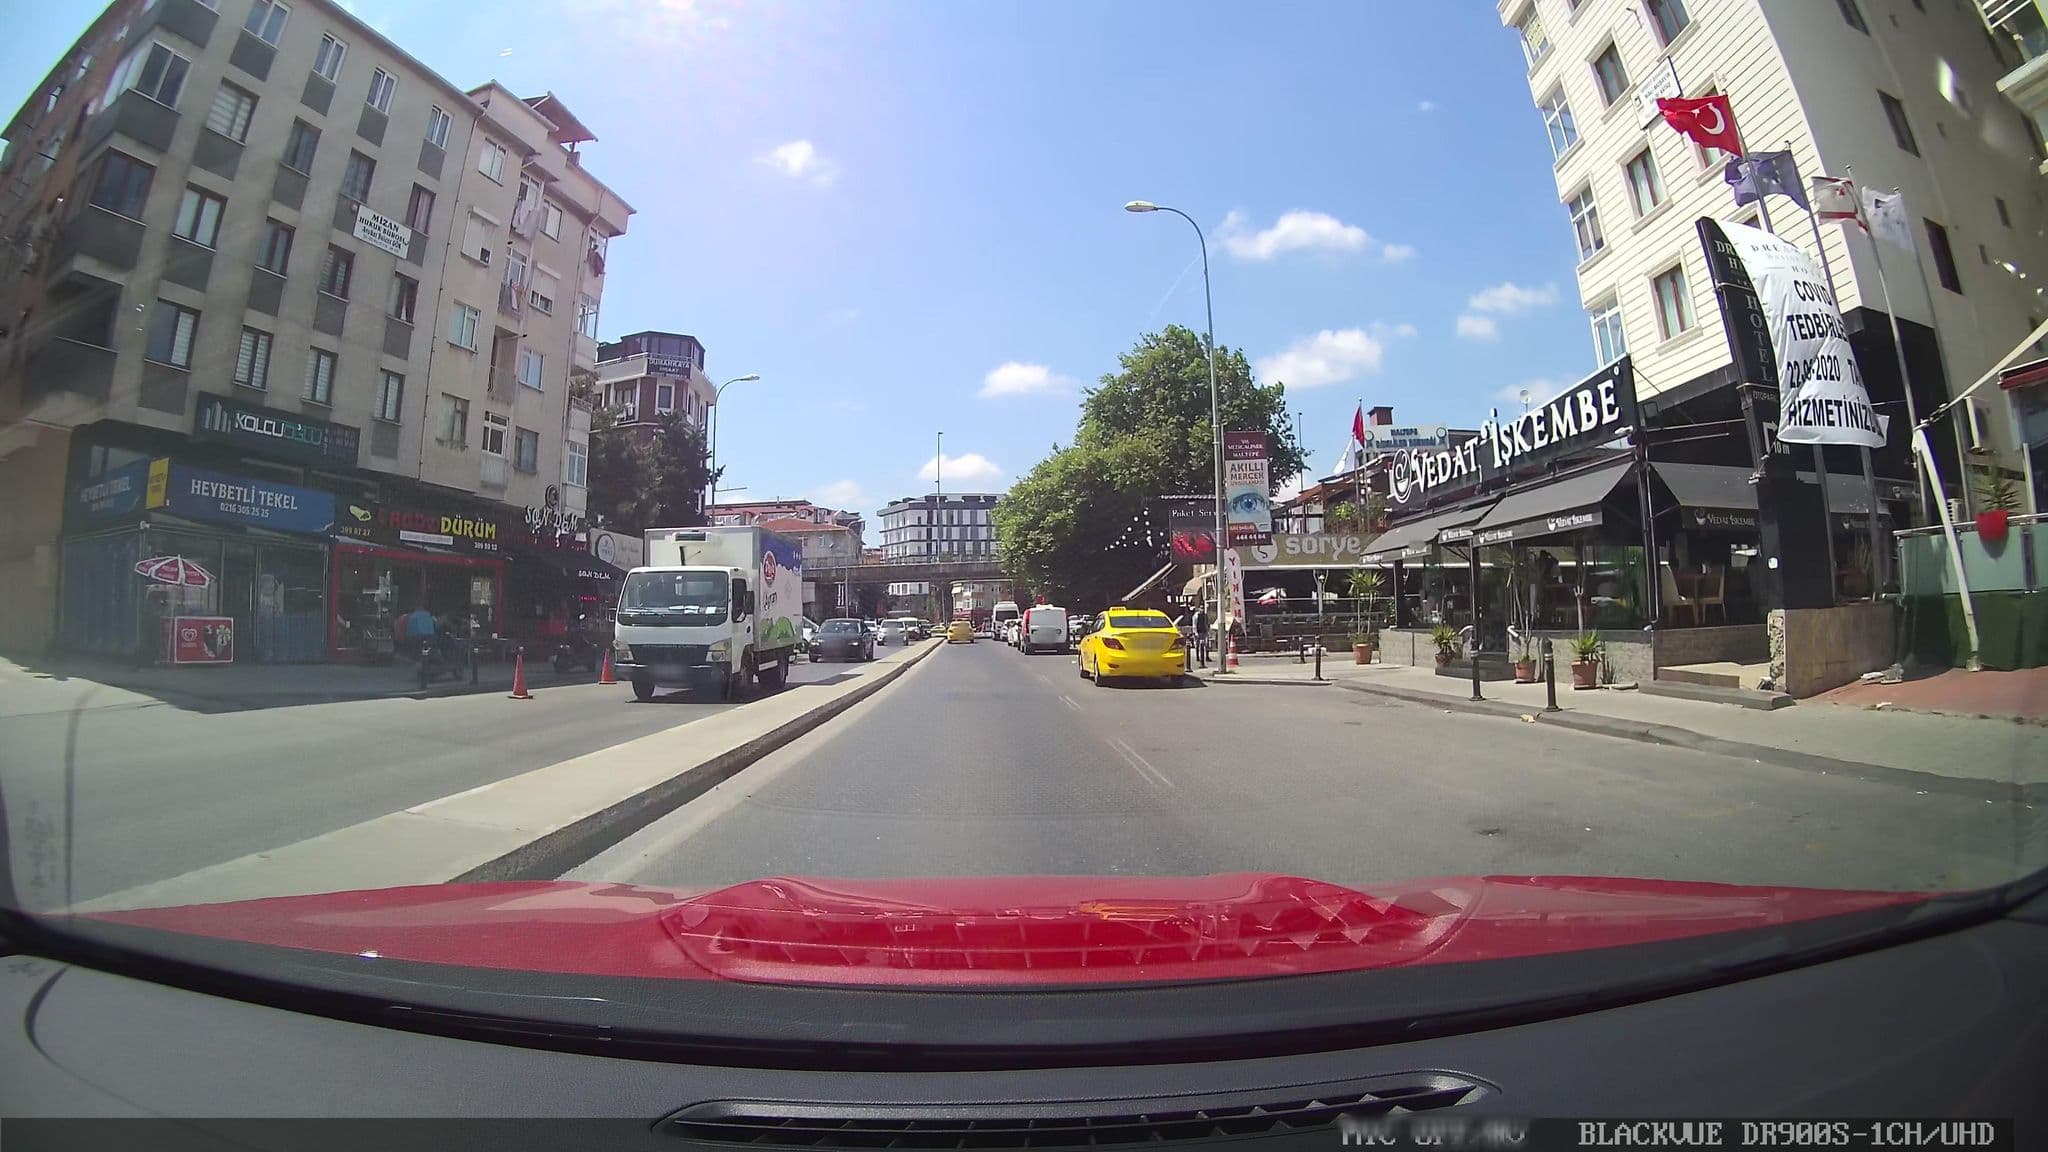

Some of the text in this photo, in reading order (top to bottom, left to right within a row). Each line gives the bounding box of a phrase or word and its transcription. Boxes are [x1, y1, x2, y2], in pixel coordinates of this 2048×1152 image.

[1794, 279, 1832, 306] COVID
[1746, 295, 1773, 381] HOTEL
[1481, 378, 1620, 470] İŞKEMBE
[190, 478, 256, 503] HEYBETLİ
[259, 490, 298, 510] TEKEL
[220, 502, 237, 513] 0216
[440, 509, 496, 539] DÜRÜM
[1172, 508, 1194, 518] Paket
